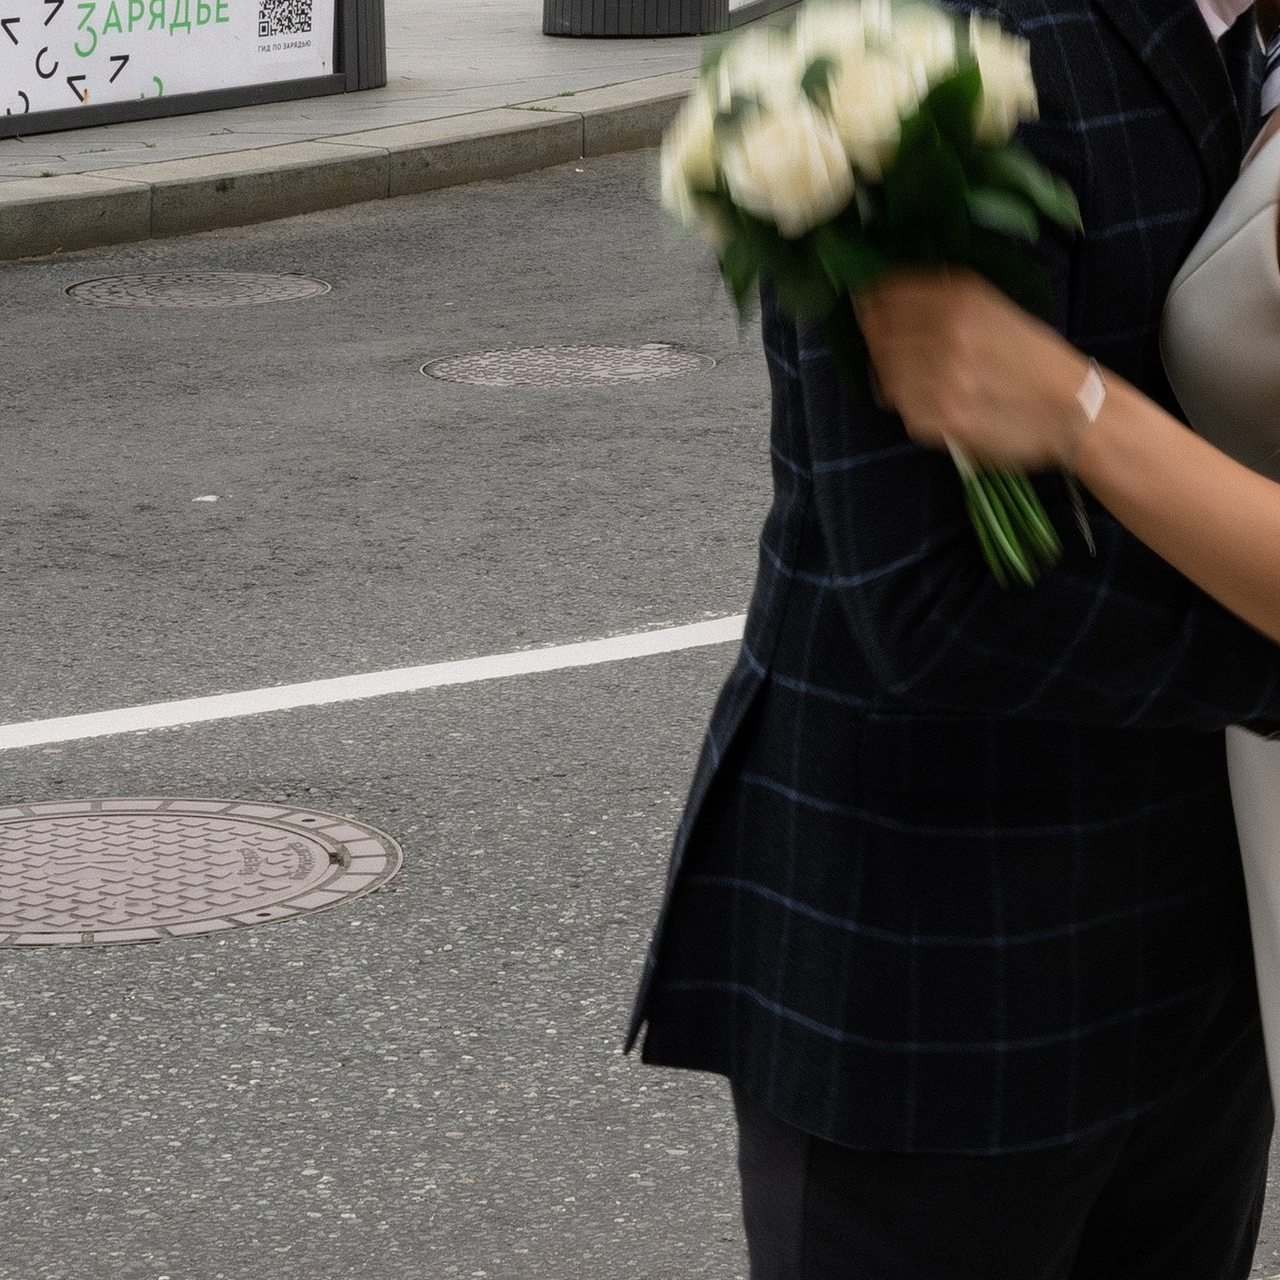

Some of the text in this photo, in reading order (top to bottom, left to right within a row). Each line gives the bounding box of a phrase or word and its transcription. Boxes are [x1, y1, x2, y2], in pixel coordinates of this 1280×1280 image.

[257, 40, 312, 53] ГИД ПО ЗАРЯДЬЮ
